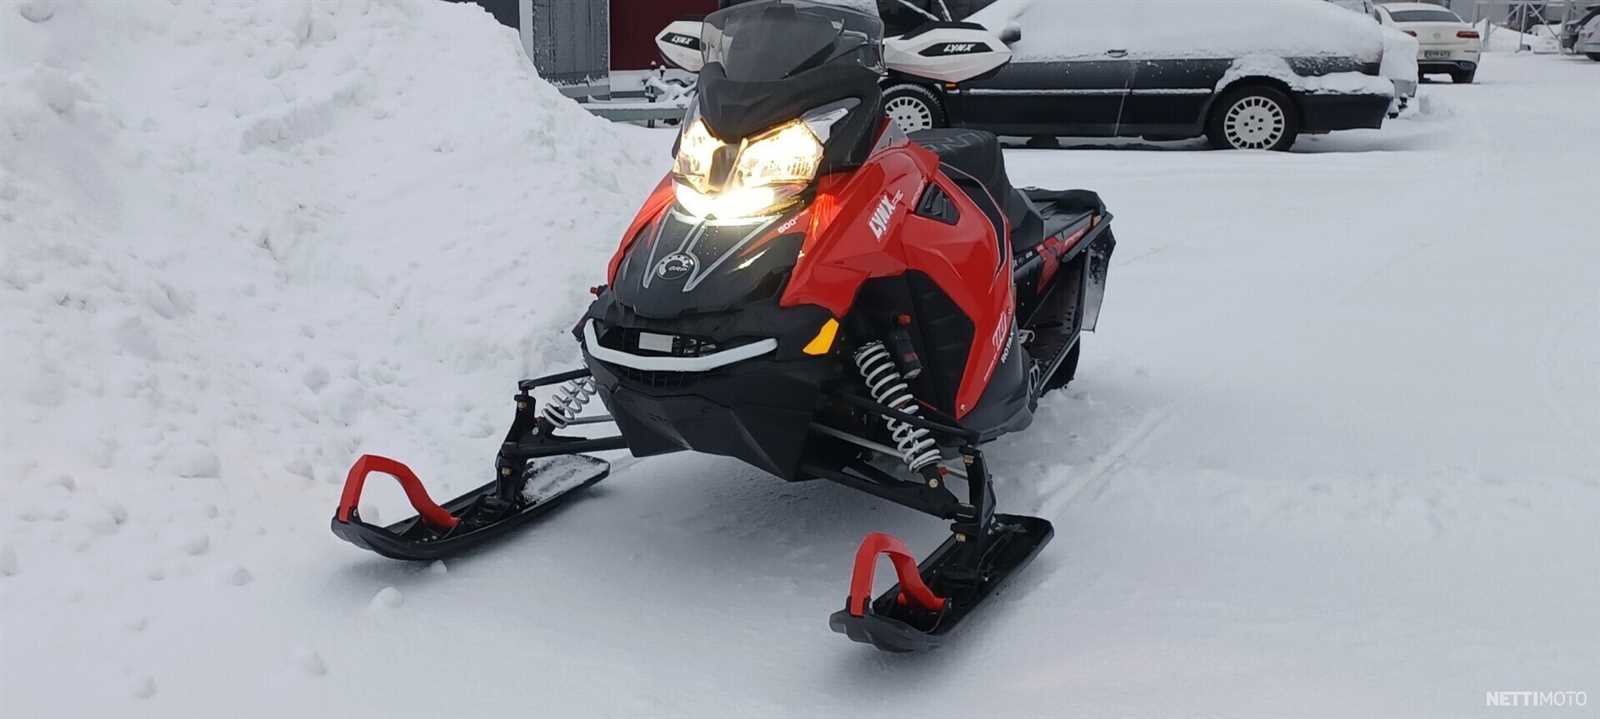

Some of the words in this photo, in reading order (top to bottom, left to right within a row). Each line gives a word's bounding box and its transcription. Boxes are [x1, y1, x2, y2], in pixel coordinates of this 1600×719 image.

[672, 34, 694, 46] LYNX
[943, 43, 977, 54] LYNX
[868, 195, 897, 242] LYNX
